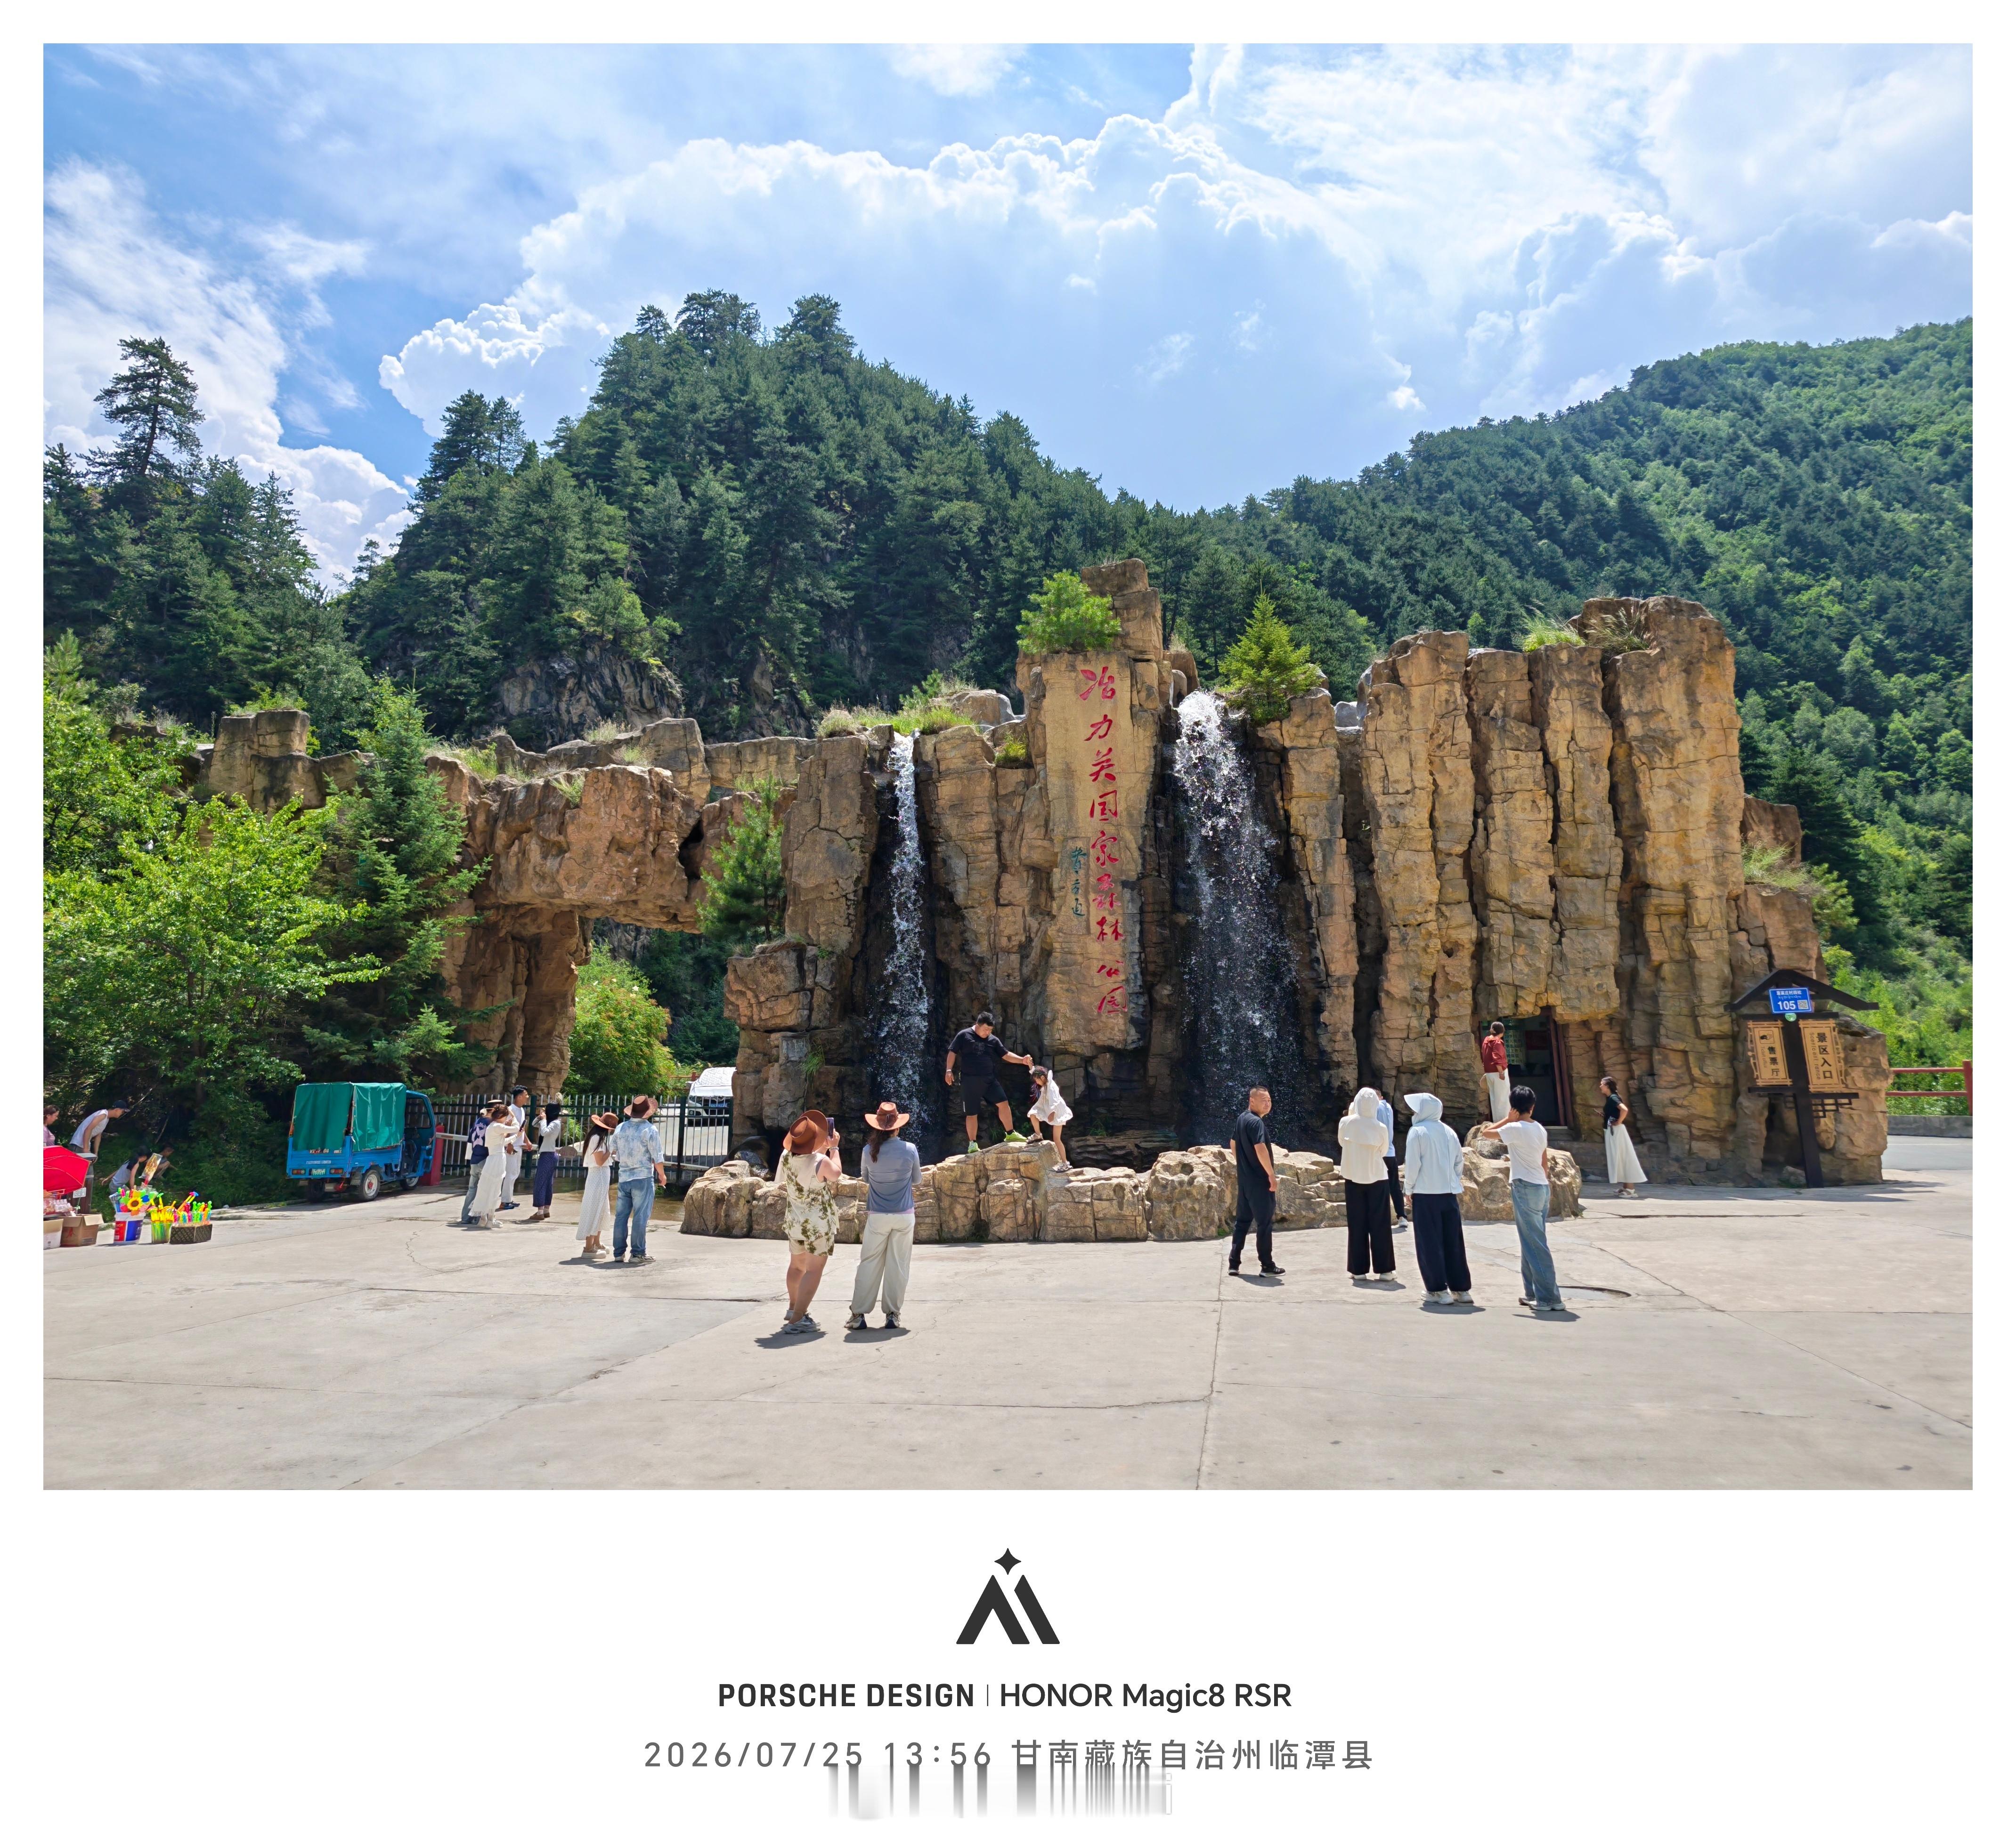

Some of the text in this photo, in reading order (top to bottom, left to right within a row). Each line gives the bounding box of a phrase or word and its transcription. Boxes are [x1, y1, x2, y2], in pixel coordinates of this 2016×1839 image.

[1079, 666, 1126, 1013] 冶力关国家森林公园
[1777, 1001, 1796, 1010] 105
[1767, 1046, 1780, 1077] 售票厅
[1816, 1032, 1833, 1079] 景区入口
